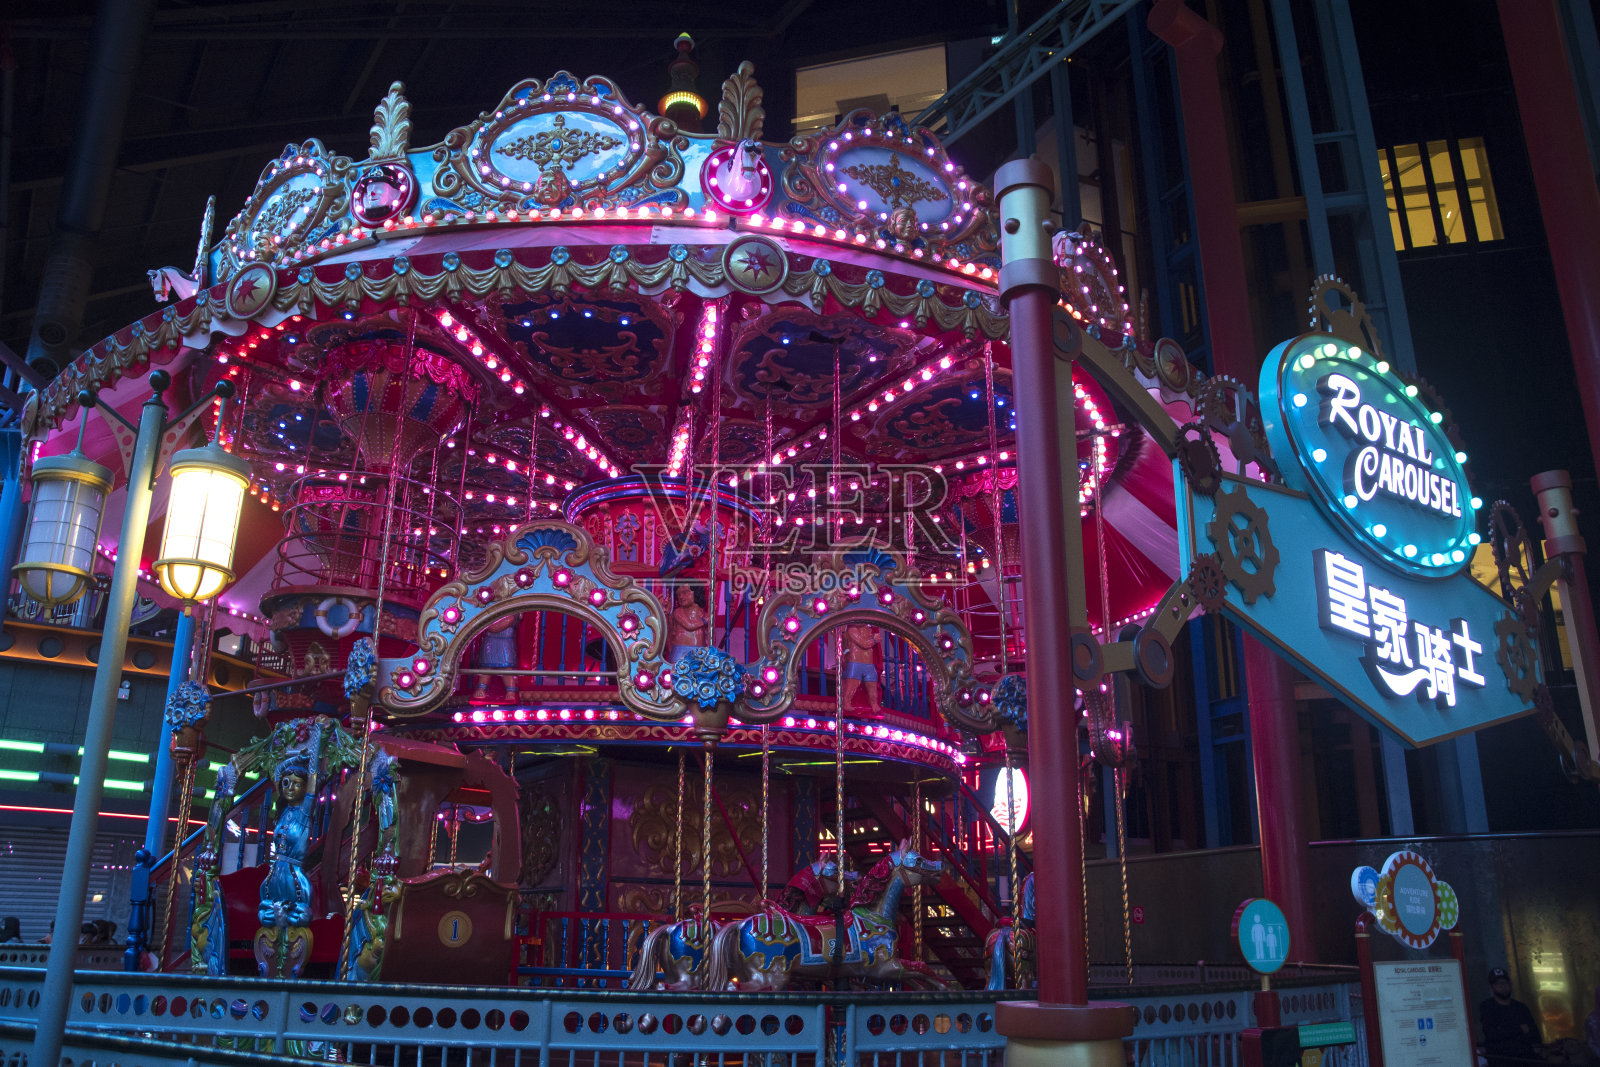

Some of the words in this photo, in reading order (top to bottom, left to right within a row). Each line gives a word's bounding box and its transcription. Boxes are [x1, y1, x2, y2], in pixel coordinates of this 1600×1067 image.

[1327, 373, 1433, 466] ROYAL
[1354, 446, 1462, 518] CAROUSEL
[451, 917, 459, 941] 1
